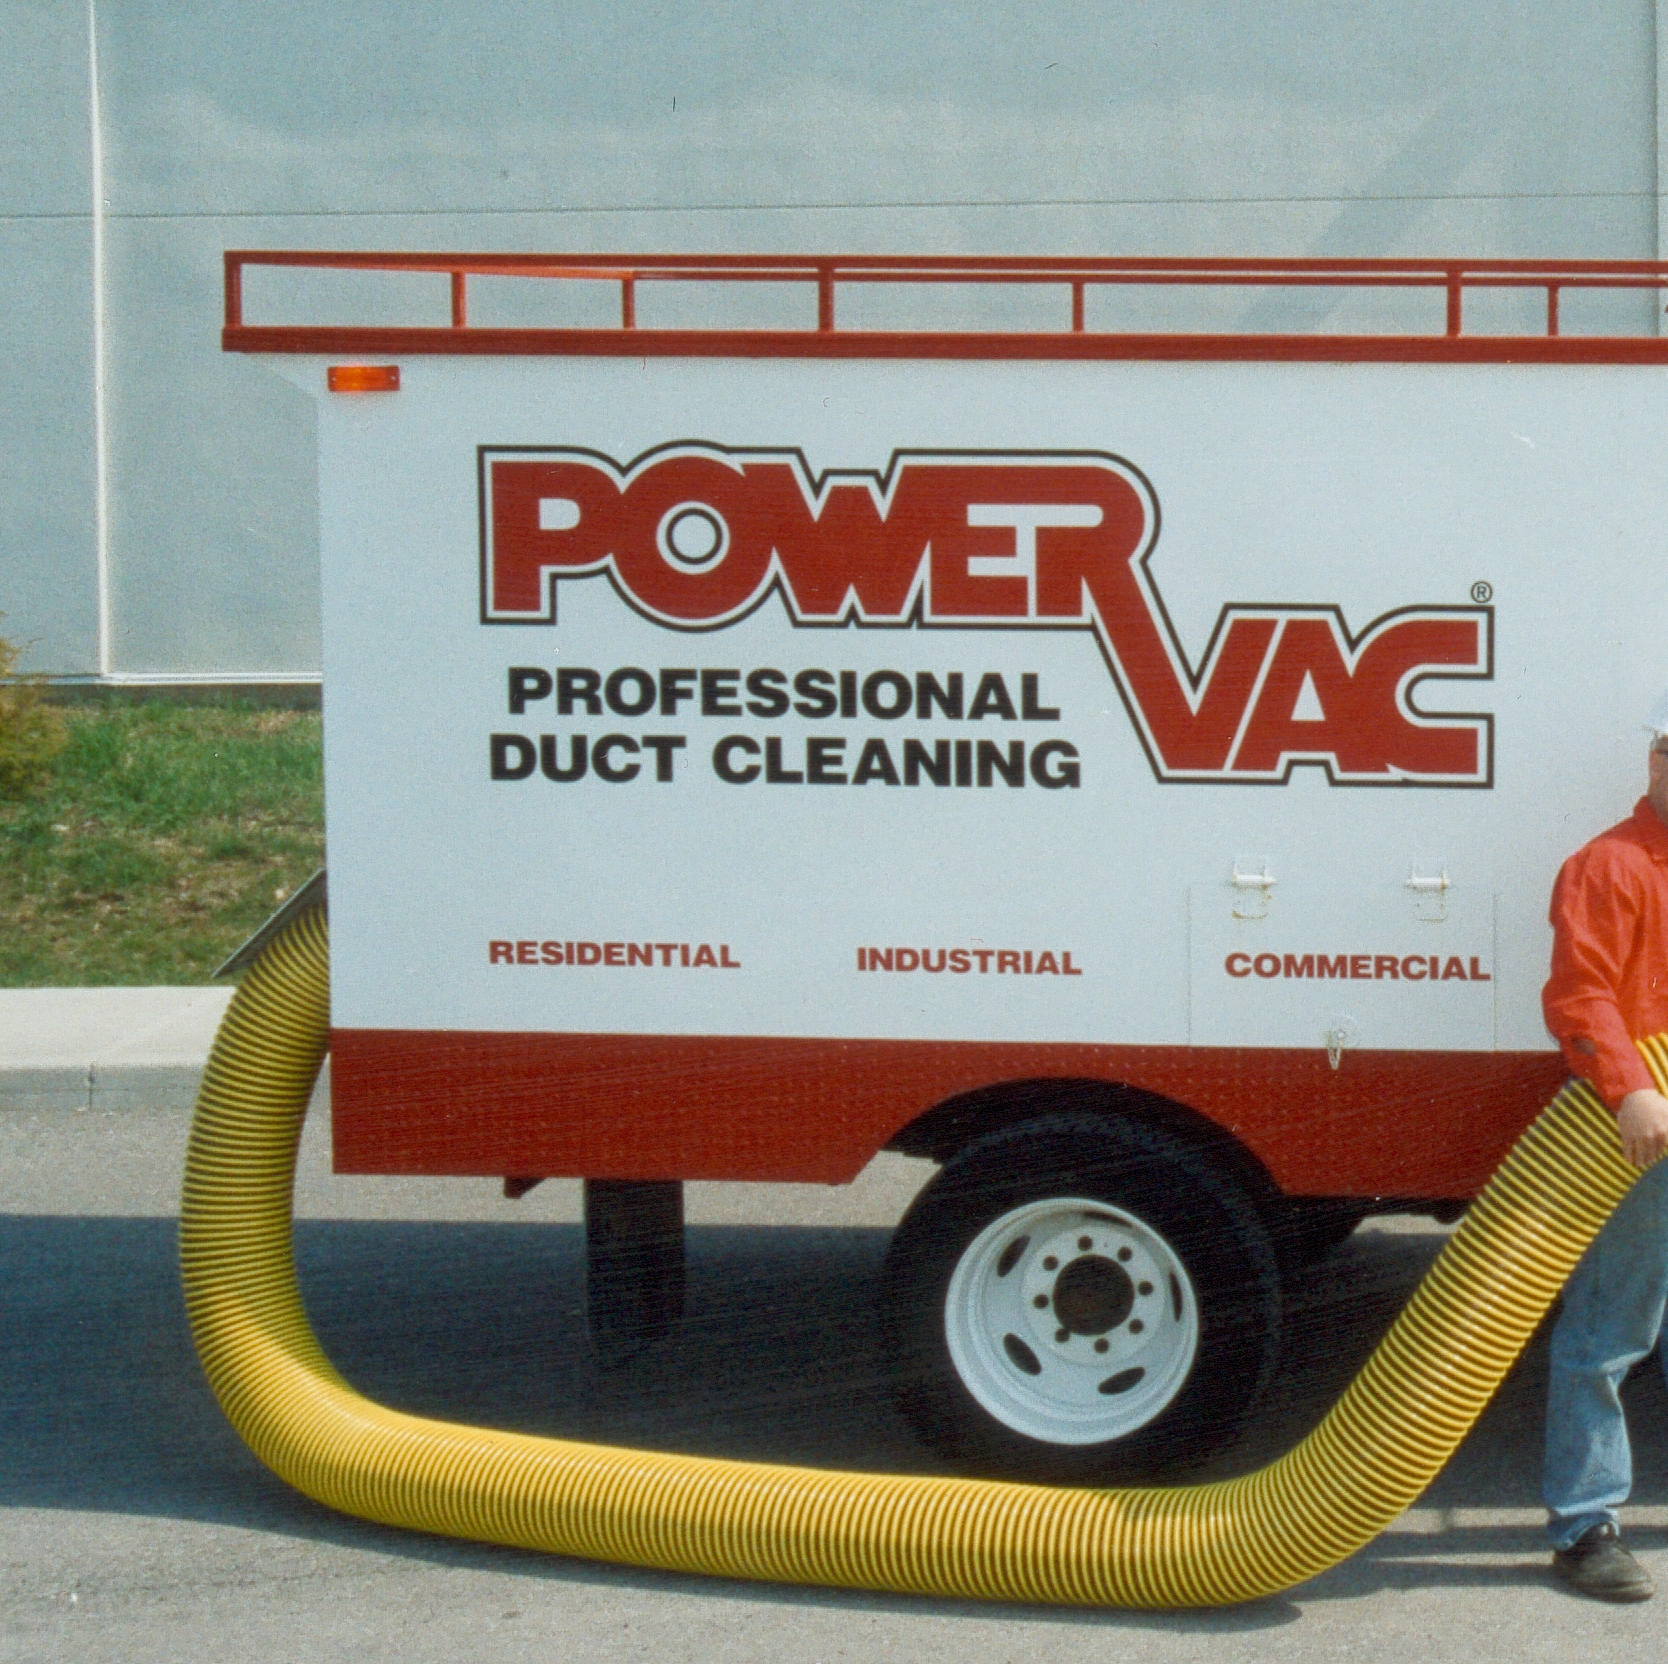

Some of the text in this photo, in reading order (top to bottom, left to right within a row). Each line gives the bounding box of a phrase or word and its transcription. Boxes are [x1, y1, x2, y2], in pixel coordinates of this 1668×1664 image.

[479, 441, 1160, 632] POWER
[507, 666, 1061, 722] PROFESSIONAL
[1092, 603, 1494, 788] VAC
[489, 733, 1081, 790] DUCT CLEANING
[488, 940, 741, 969] RESIDENTIAL
[857, 947, 1083, 976] INDUSTRIAL
[1224, 952, 1491, 982] COMMERCIAL
